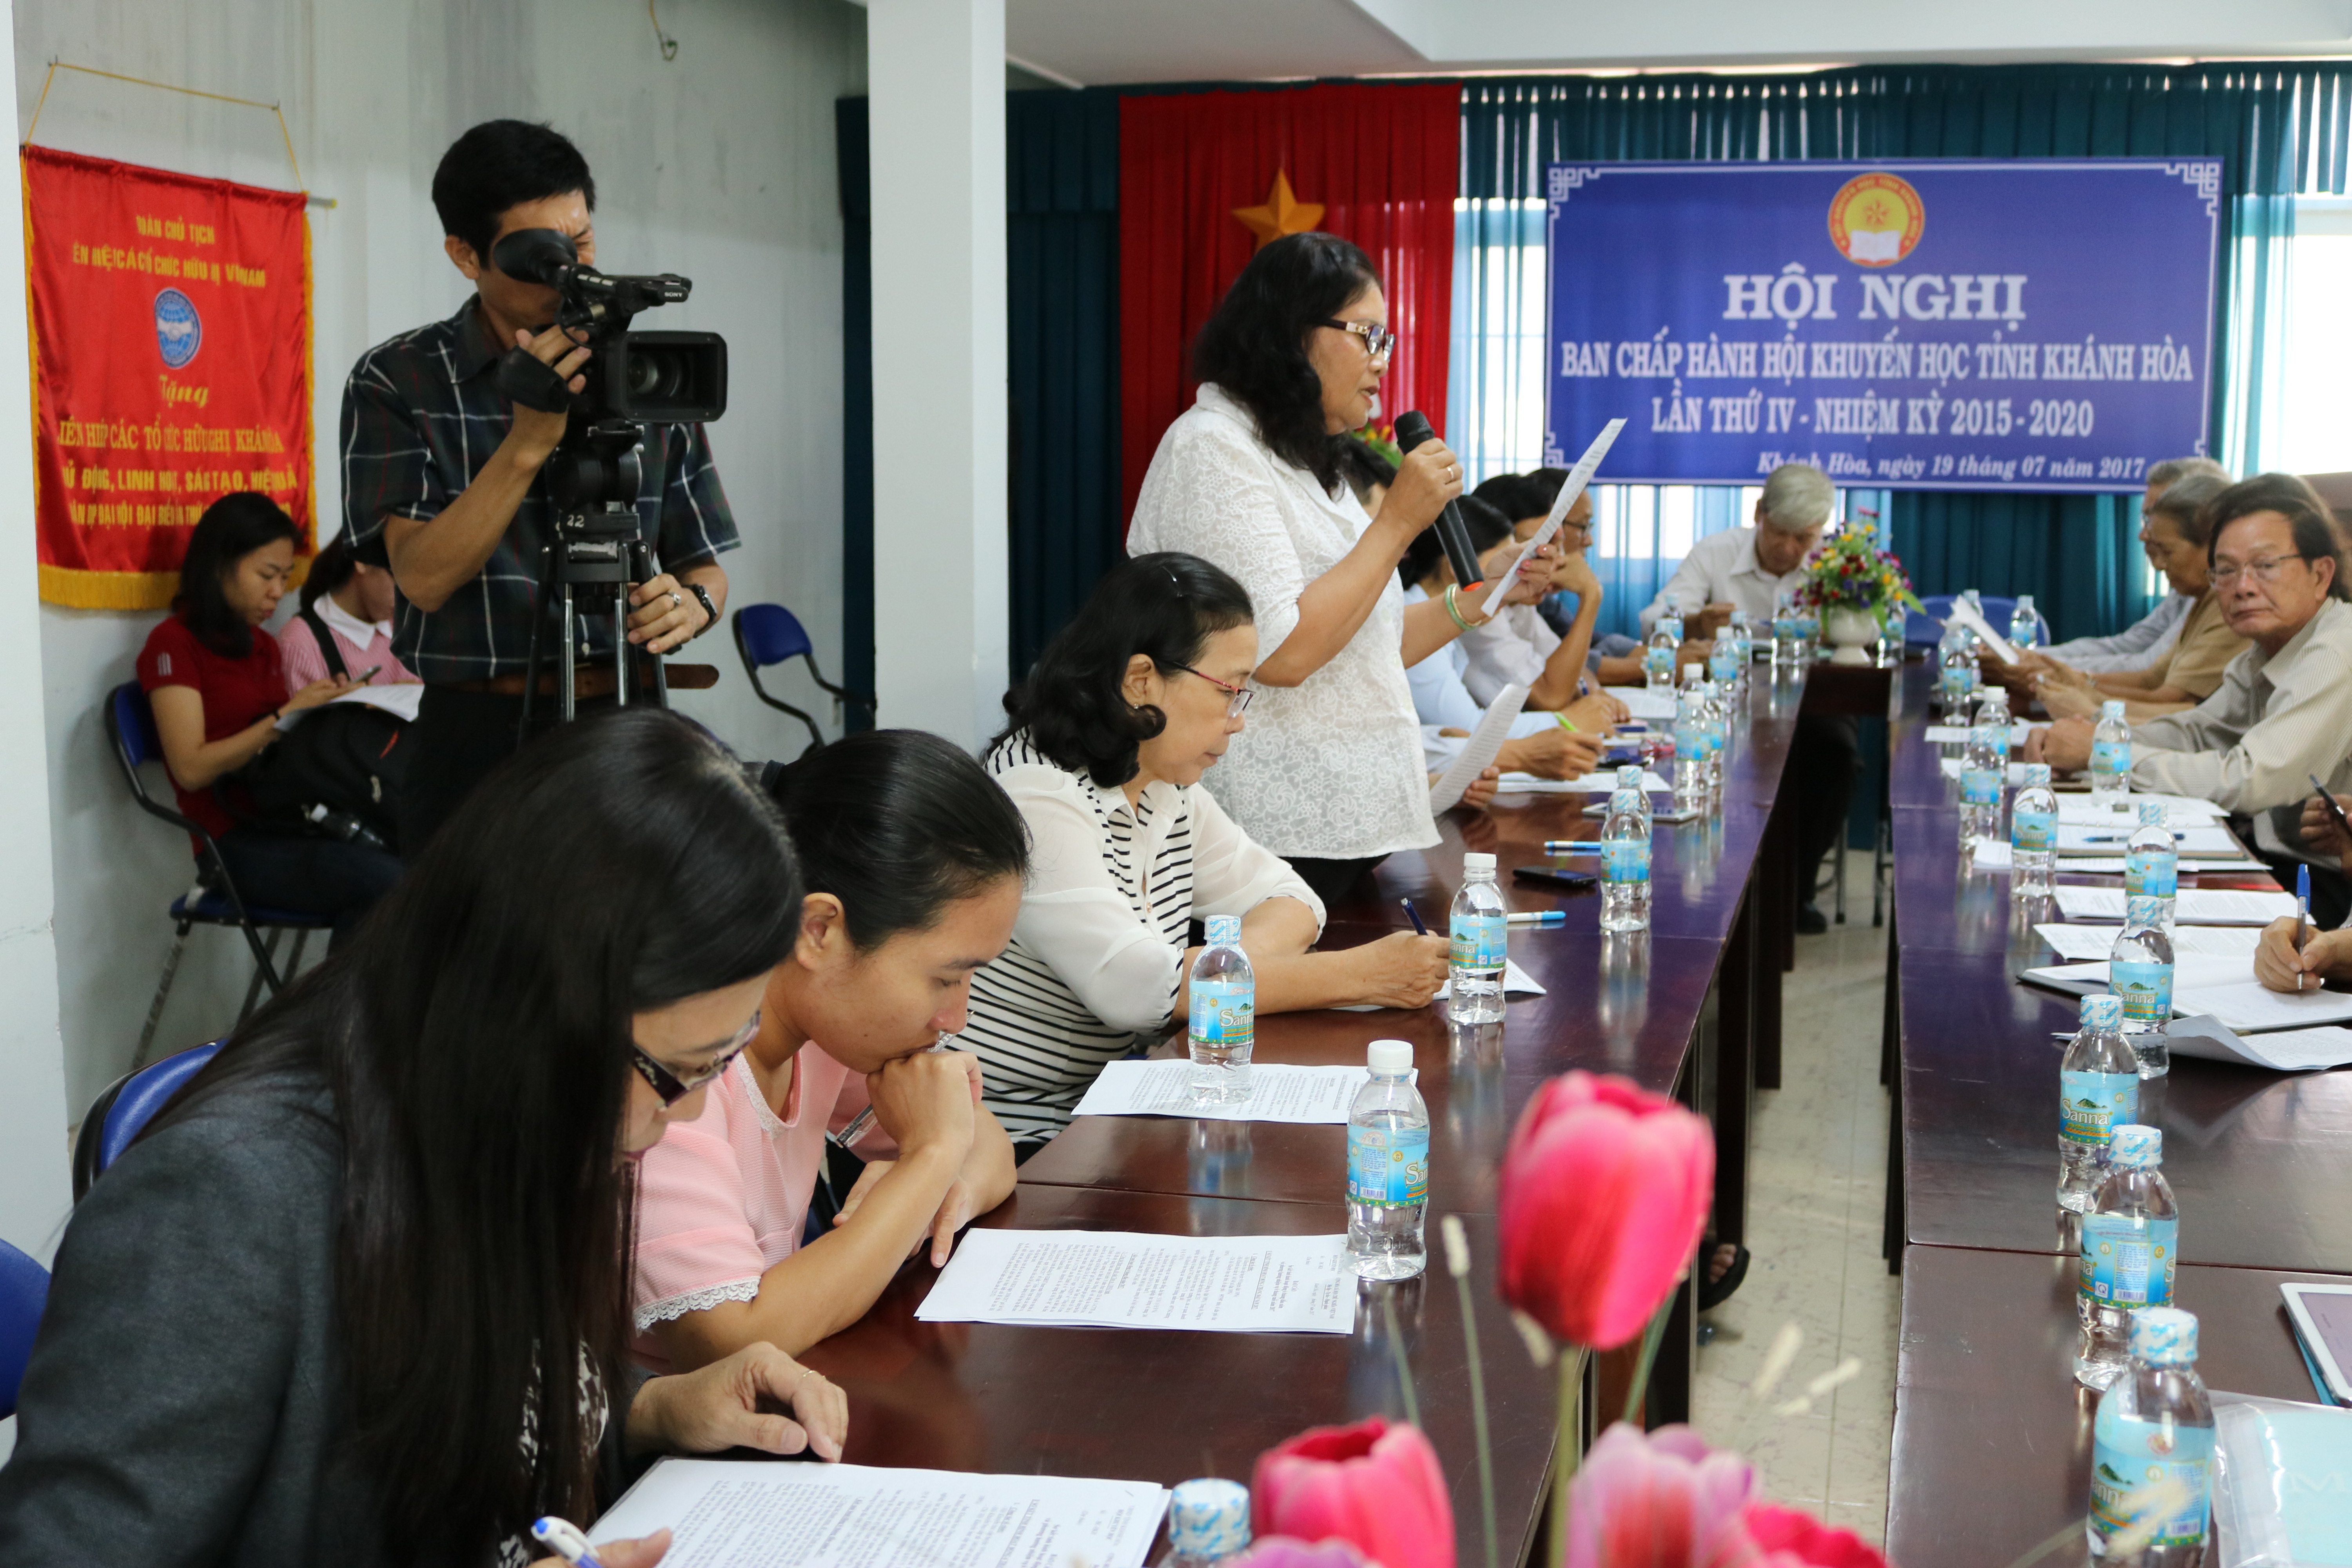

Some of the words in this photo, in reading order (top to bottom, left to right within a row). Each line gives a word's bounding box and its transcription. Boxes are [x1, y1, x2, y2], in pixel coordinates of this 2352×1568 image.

[1723, 262, 1837, 330] HỘI
[1859, 274, 2027, 331] NGHỊ
[1561, 342, 1611, 377] BAN
[1616, 325, 1682, 378] CHẤP
[1686, 332, 1758, 377] HÀNH
[1762, 332, 1807, 385] HỘI
[1811, 326, 1914, 379] KHUYẾN
[1918, 343, 1969, 388] HỌC
[1976, 330, 2038, 379] TỈNH
[2043, 333, 2136, 381] KHÁNH
[2140, 334, 2193, 381] HÒA
[160, 374, 209, 408] Tặng
[1651, 377, 1702, 433] LẦN
[1708, 387, 1763, 434] THỨ
[1767, 397, 1796, 433] IV
[1815, 389, 1900, 442] NHIỆM
[1906, 388, 1945, 435] KỲ
[110, 417, 138, 450] CÁC
[118, 469, 154, 491] LINH
[1828, 451, 1871, 477] Hòa,
[1878, 454, 1926, 480] ngày
[1932, 456, 1954, 476] 19
[1960, 455, 2014, 481] tháng
[2021, 457, 2045, 477] 07
[2049, 458, 2093, 479] năm
[2098, 457, 2146, 479] 2017
[567, 514, 584, 528] 22
[1450, 942, 1476, 954] anna
[2062, 1098, 2110, 1125] Sanna
